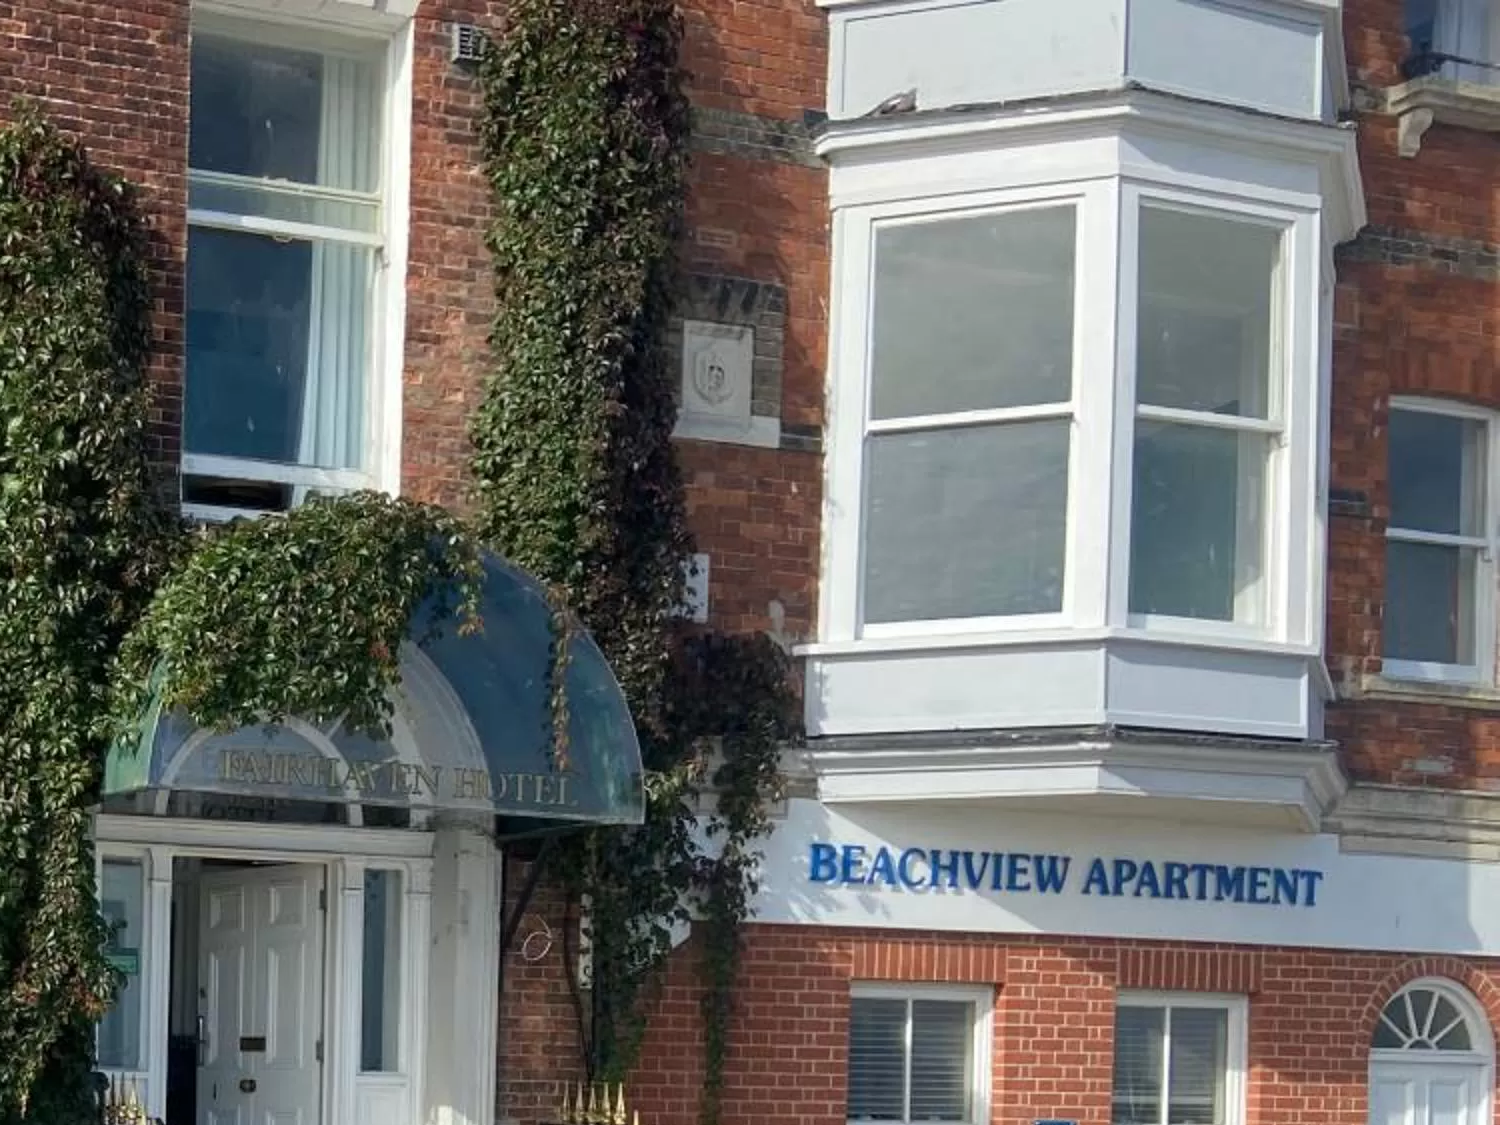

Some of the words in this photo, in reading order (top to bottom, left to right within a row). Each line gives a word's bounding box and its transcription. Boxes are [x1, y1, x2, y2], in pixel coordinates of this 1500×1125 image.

[220, 749, 440, 796] FAIRHAVEN
[453, 765, 578, 807] HOTEL
[808, 842, 1071, 895] BEACHVIEW
[1081, 857, 1323, 907] APARTMENT
